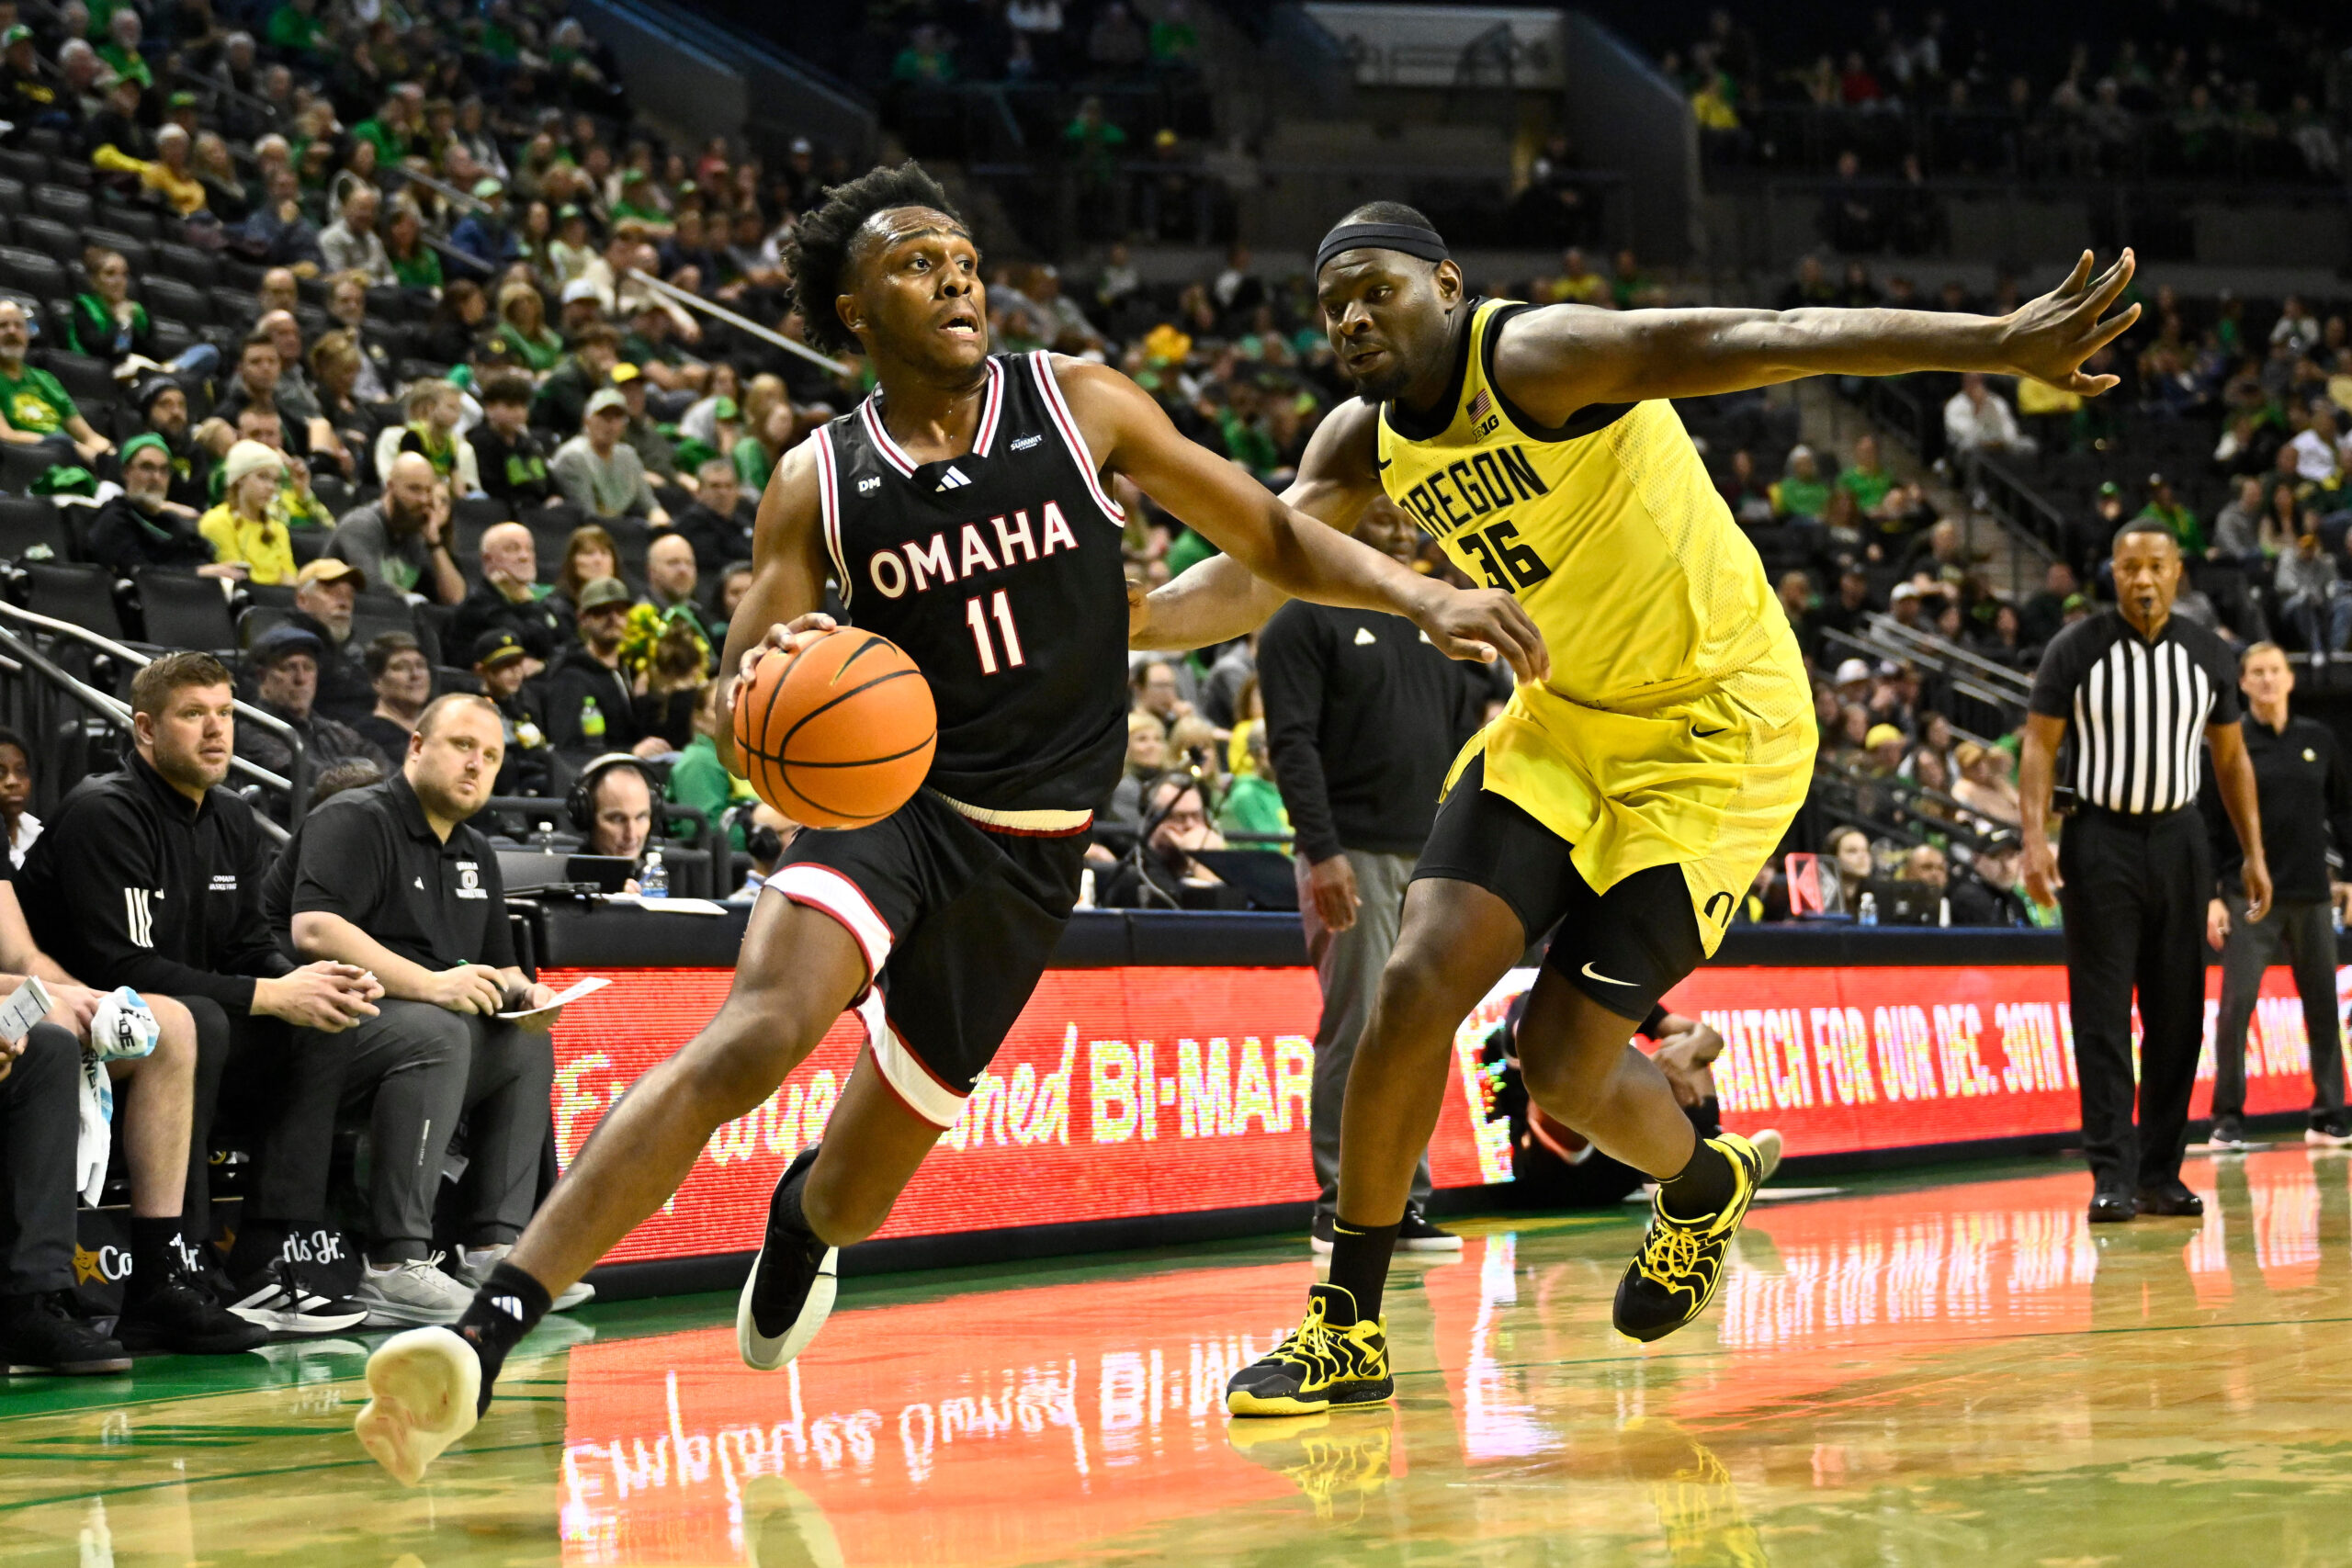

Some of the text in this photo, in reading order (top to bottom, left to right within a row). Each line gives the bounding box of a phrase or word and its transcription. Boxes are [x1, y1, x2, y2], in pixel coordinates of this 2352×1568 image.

[858, 476, 881, 492] DM
[869, 500, 1080, 599] OMAHA
[1457, 520, 1552, 595] 36
[966, 588, 1026, 677] 11
[1089, 1035, 1315, 1145] BI-MAR
[1809, 1007, 1877, 1107] FOR
[1873, 1006, 1938, 1101] OUR
[1932, 1003, 1999, 1099] DEC.
[1995, 1001, 2064, 1094] 30TH
[283, 1230, 345, 1265] rl's Jr.
